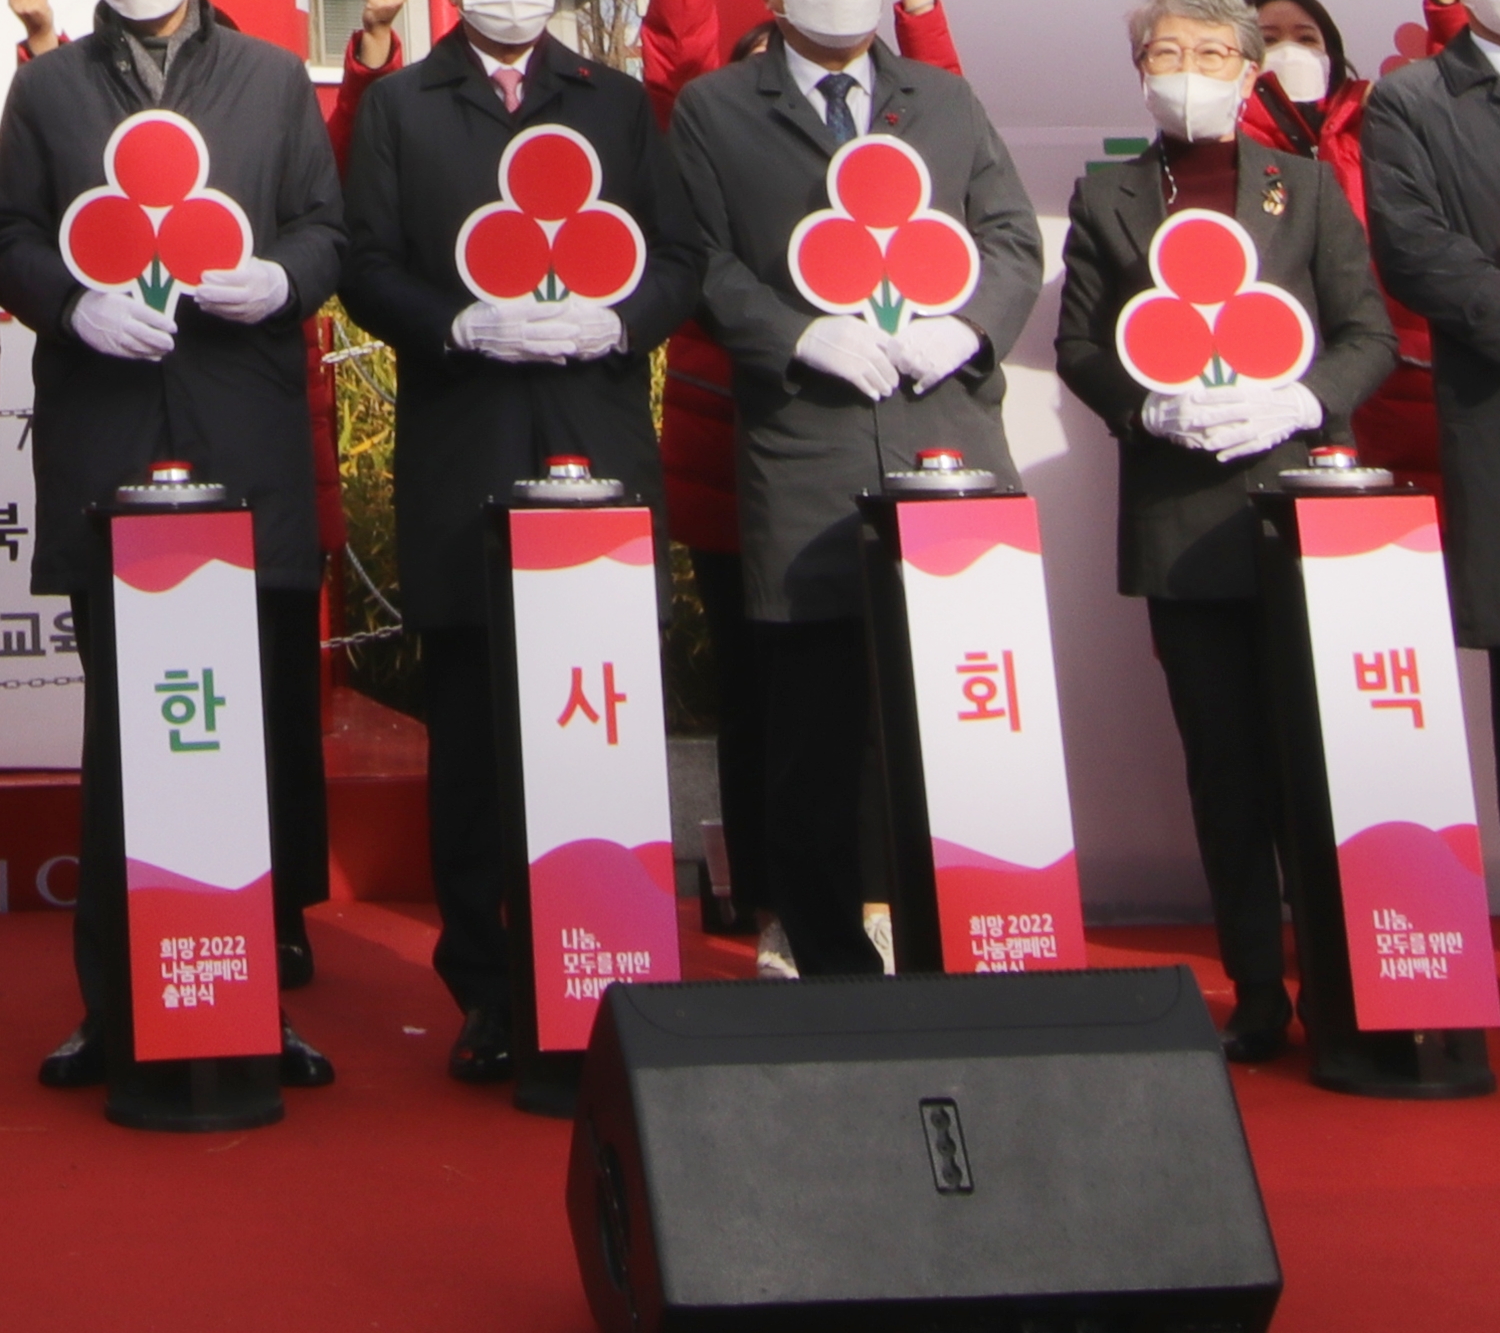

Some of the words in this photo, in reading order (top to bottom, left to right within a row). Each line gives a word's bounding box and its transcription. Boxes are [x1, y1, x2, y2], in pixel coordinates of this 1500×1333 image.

[956, 650, 1022, 732] 회
[1352, 647, 1425, 729] 백
[154, 668, 226, 752] 한
[556, 661, 627, 745] 사
[969, 915, 1004, 936] 희망
[1008, 914, 1053, 933] 2022
[160, 937, 196, 960] 희망
[200, 936, 246, 956] 2022
[971, 937, 1057, 959] 나눔캠페인
[1376, 933, 1427, 955] 모두를
[1429, 931, 1463, 954] 위한
[160, 959, 248, 982] 나눔캠페인
[563, 951, 613, 974] 모두를
[616, 951, 651, 974] 위한
[1379, 957, 1448, 979] 사회백신
[162, 983, 215, 1006] 출범식
